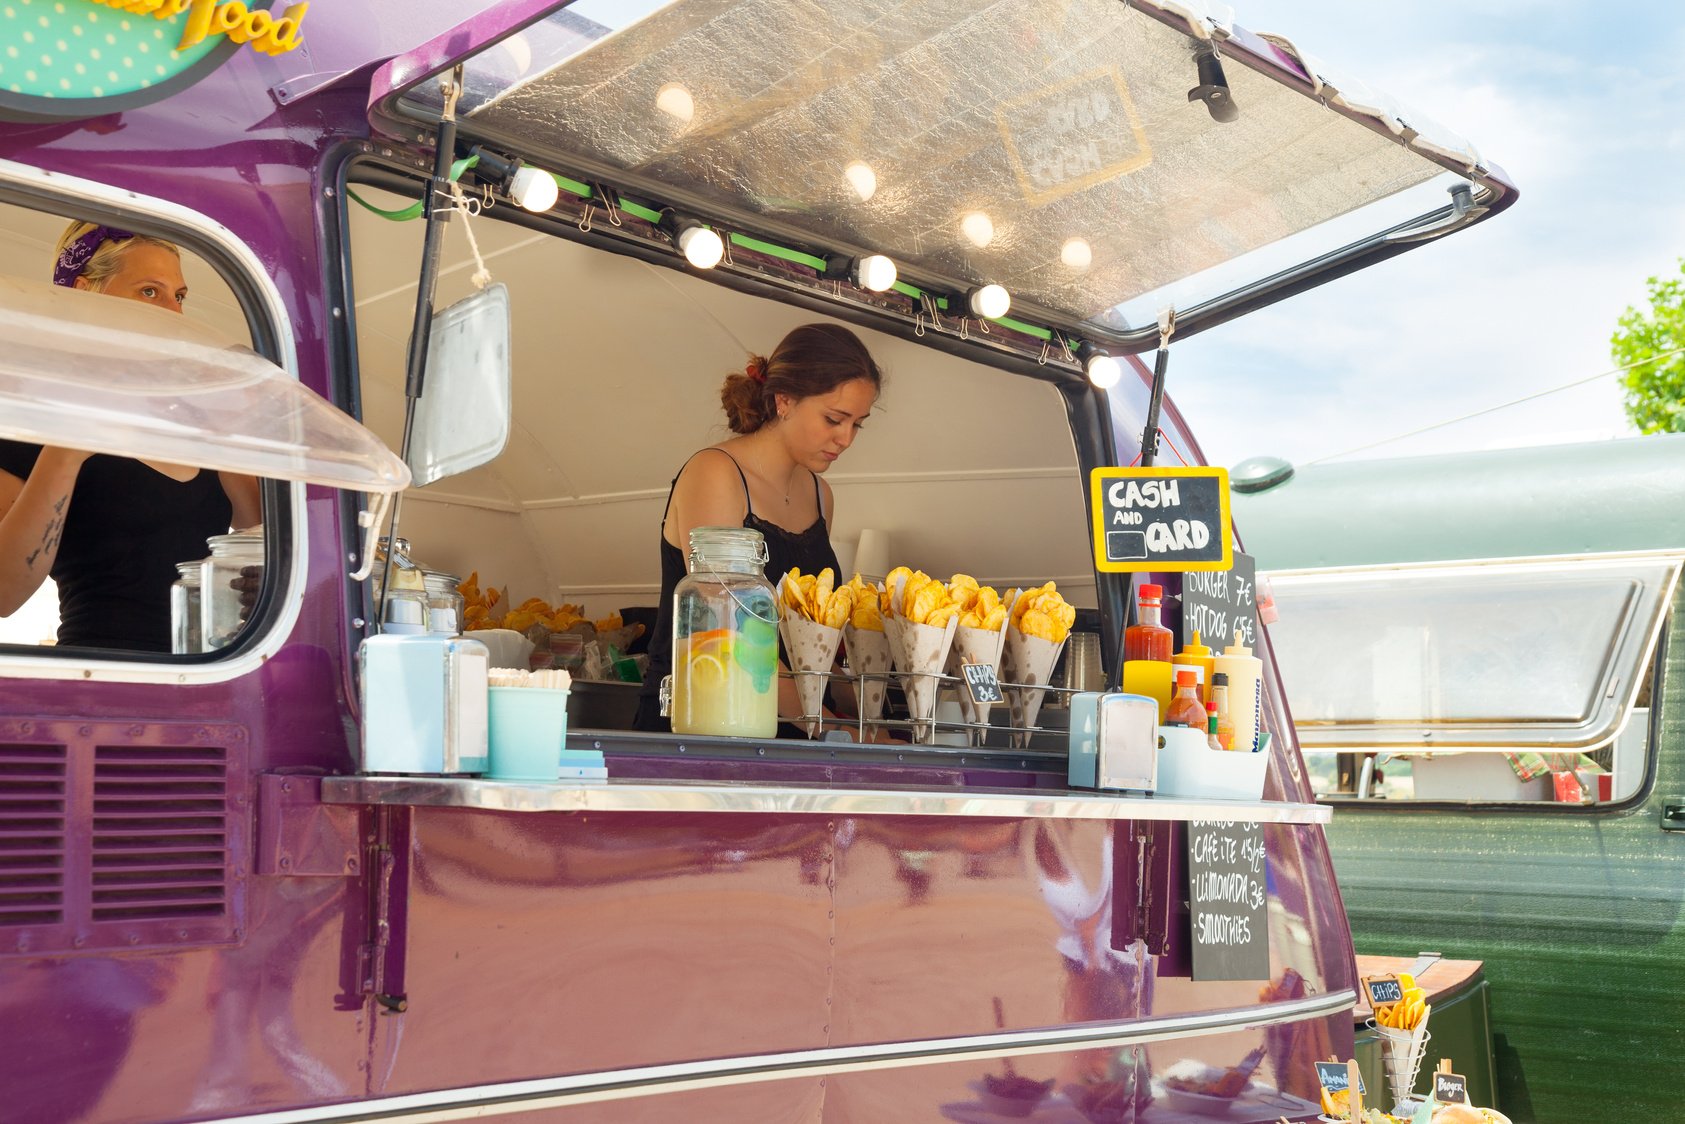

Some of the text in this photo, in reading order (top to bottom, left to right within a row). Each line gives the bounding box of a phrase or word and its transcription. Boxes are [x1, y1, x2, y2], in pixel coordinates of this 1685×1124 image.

[1108, 479, 1181, 508] CASH
[1113, 511, 1143, 525] AND
[1146, 519, 1210, 553] CARD
[1189, 571, 1252, 606] BURGER 7€
[978, 686, 998, 702] 3€
[1250, 880, 1265, 910] 3€
[1371, 982, 1402, 1000] CHiPS
